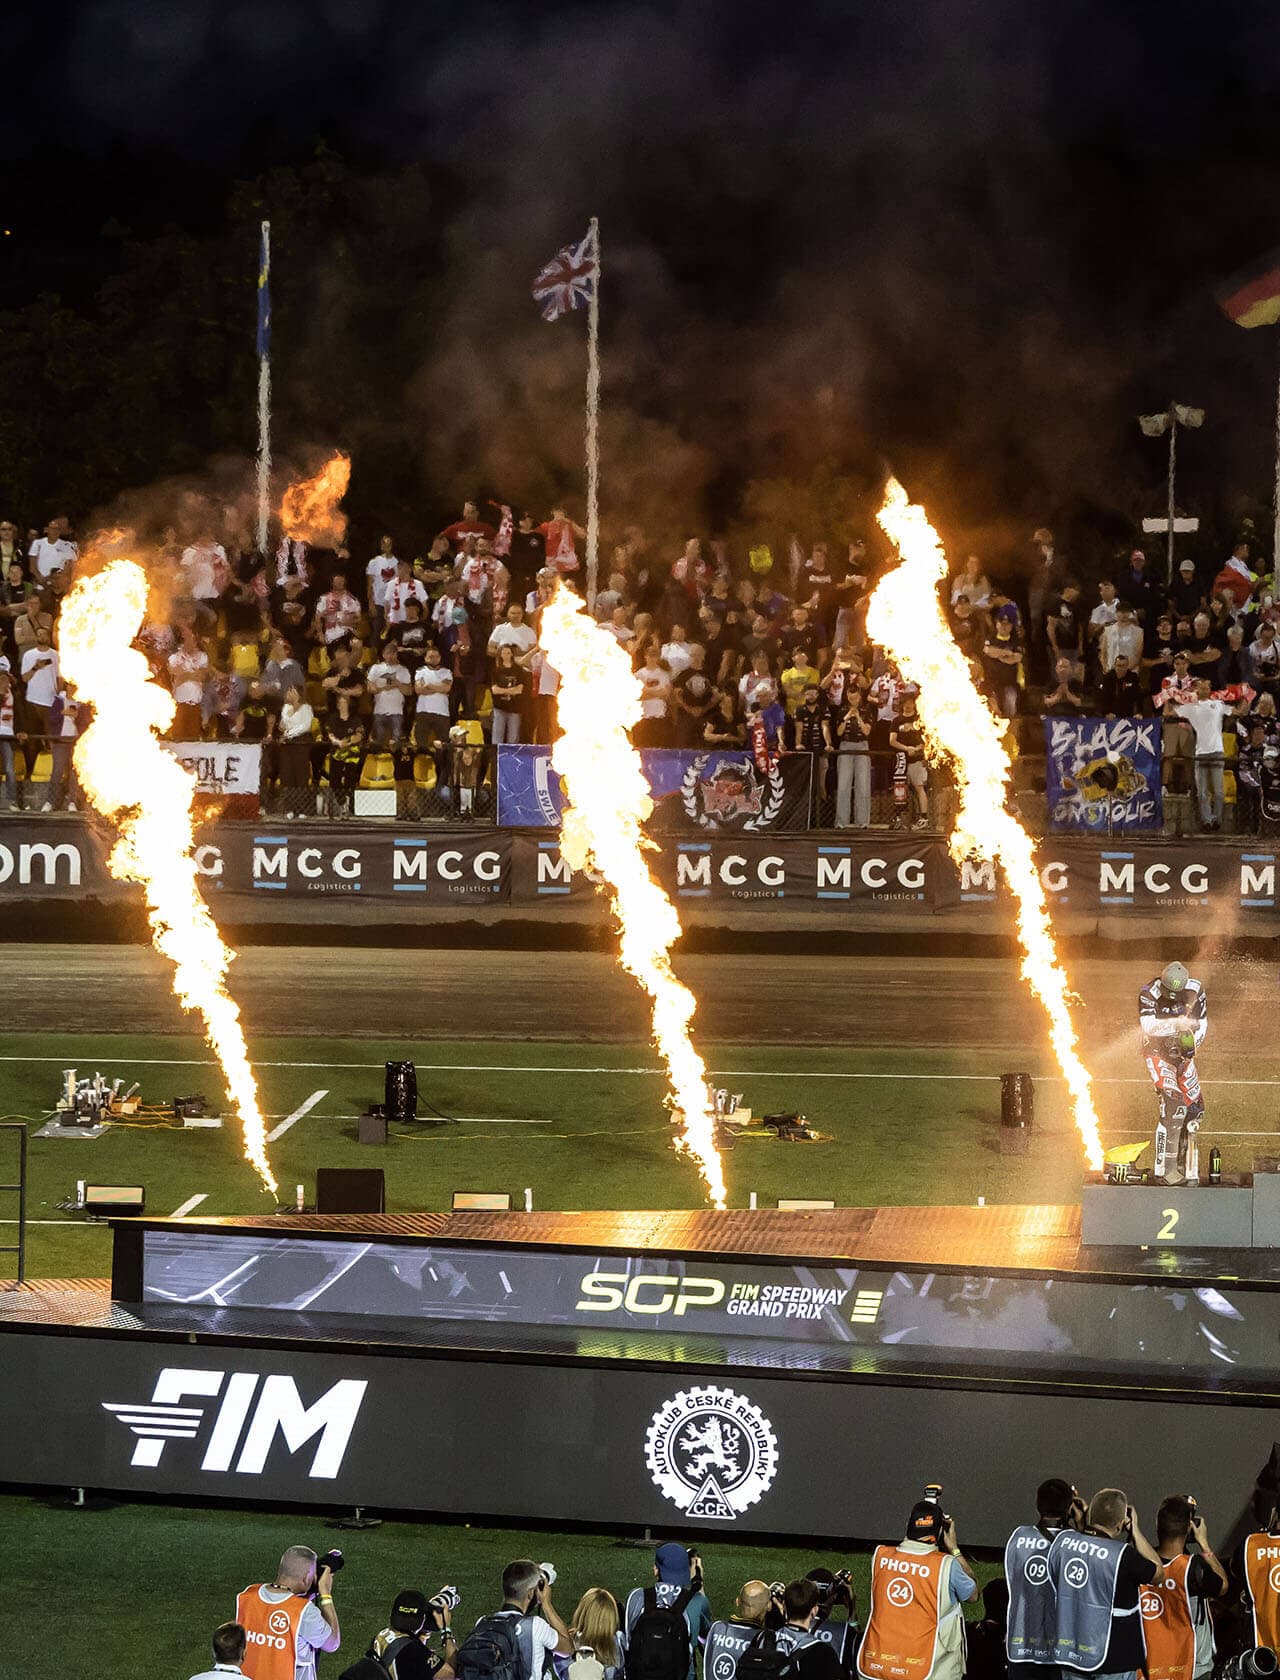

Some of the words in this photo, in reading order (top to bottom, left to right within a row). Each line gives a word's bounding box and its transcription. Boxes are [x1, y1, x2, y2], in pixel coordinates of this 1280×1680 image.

[253, 847, 361, 879] MCG
[393, 850, 500, 881] MCG
[677, 854, 785, 887] MCG
[817, 857, 925, 889] MCG
[961, 860, 1070, 893] MG
[1100, 863, 1208, 894] MCG
[448, 885, 492, 894] Logistics
[731, 889, 776, 899] Logistics
[872, 892, 917, 901] Logistics
[1156, 1209, 1180, 1240] 2
[575, 1273, 726, 1316] SGP
[731, 1283, 760, 1300] FIM
[760, 1285, 849, 1306] SPEEDWAY
[726, 1299, 784, 1318] GRAND
[785, 1303, 825, 1320] PRIX
[101, 1368, 368, 1479] FIM
[654, 1406, 682, 1476] AUTOKLUB
[685, 1395, 734, 1410] ČESKÉ
[735, 1405, 769, 1481] REPUBLIKY
[693, 1502, 728, 1516] CCR
[1016, 1536, 1049, 1551] PHO
[1061, 1537, 1109, 1560] PHOTO
[879, 1556, 931, 1578] PHOTO
[1029, 1563, 1046, 1578] 09
[1070, 1565, 1083, 1581] 28
[891, 1584, 909, 1600] 24
[1142, 1598, 1160, 1613] 28
[272, 1615, 287, 1628] 26
[246, 1630, 286, 1649] HOTO
[717, 1660, 731, 1676] 36
